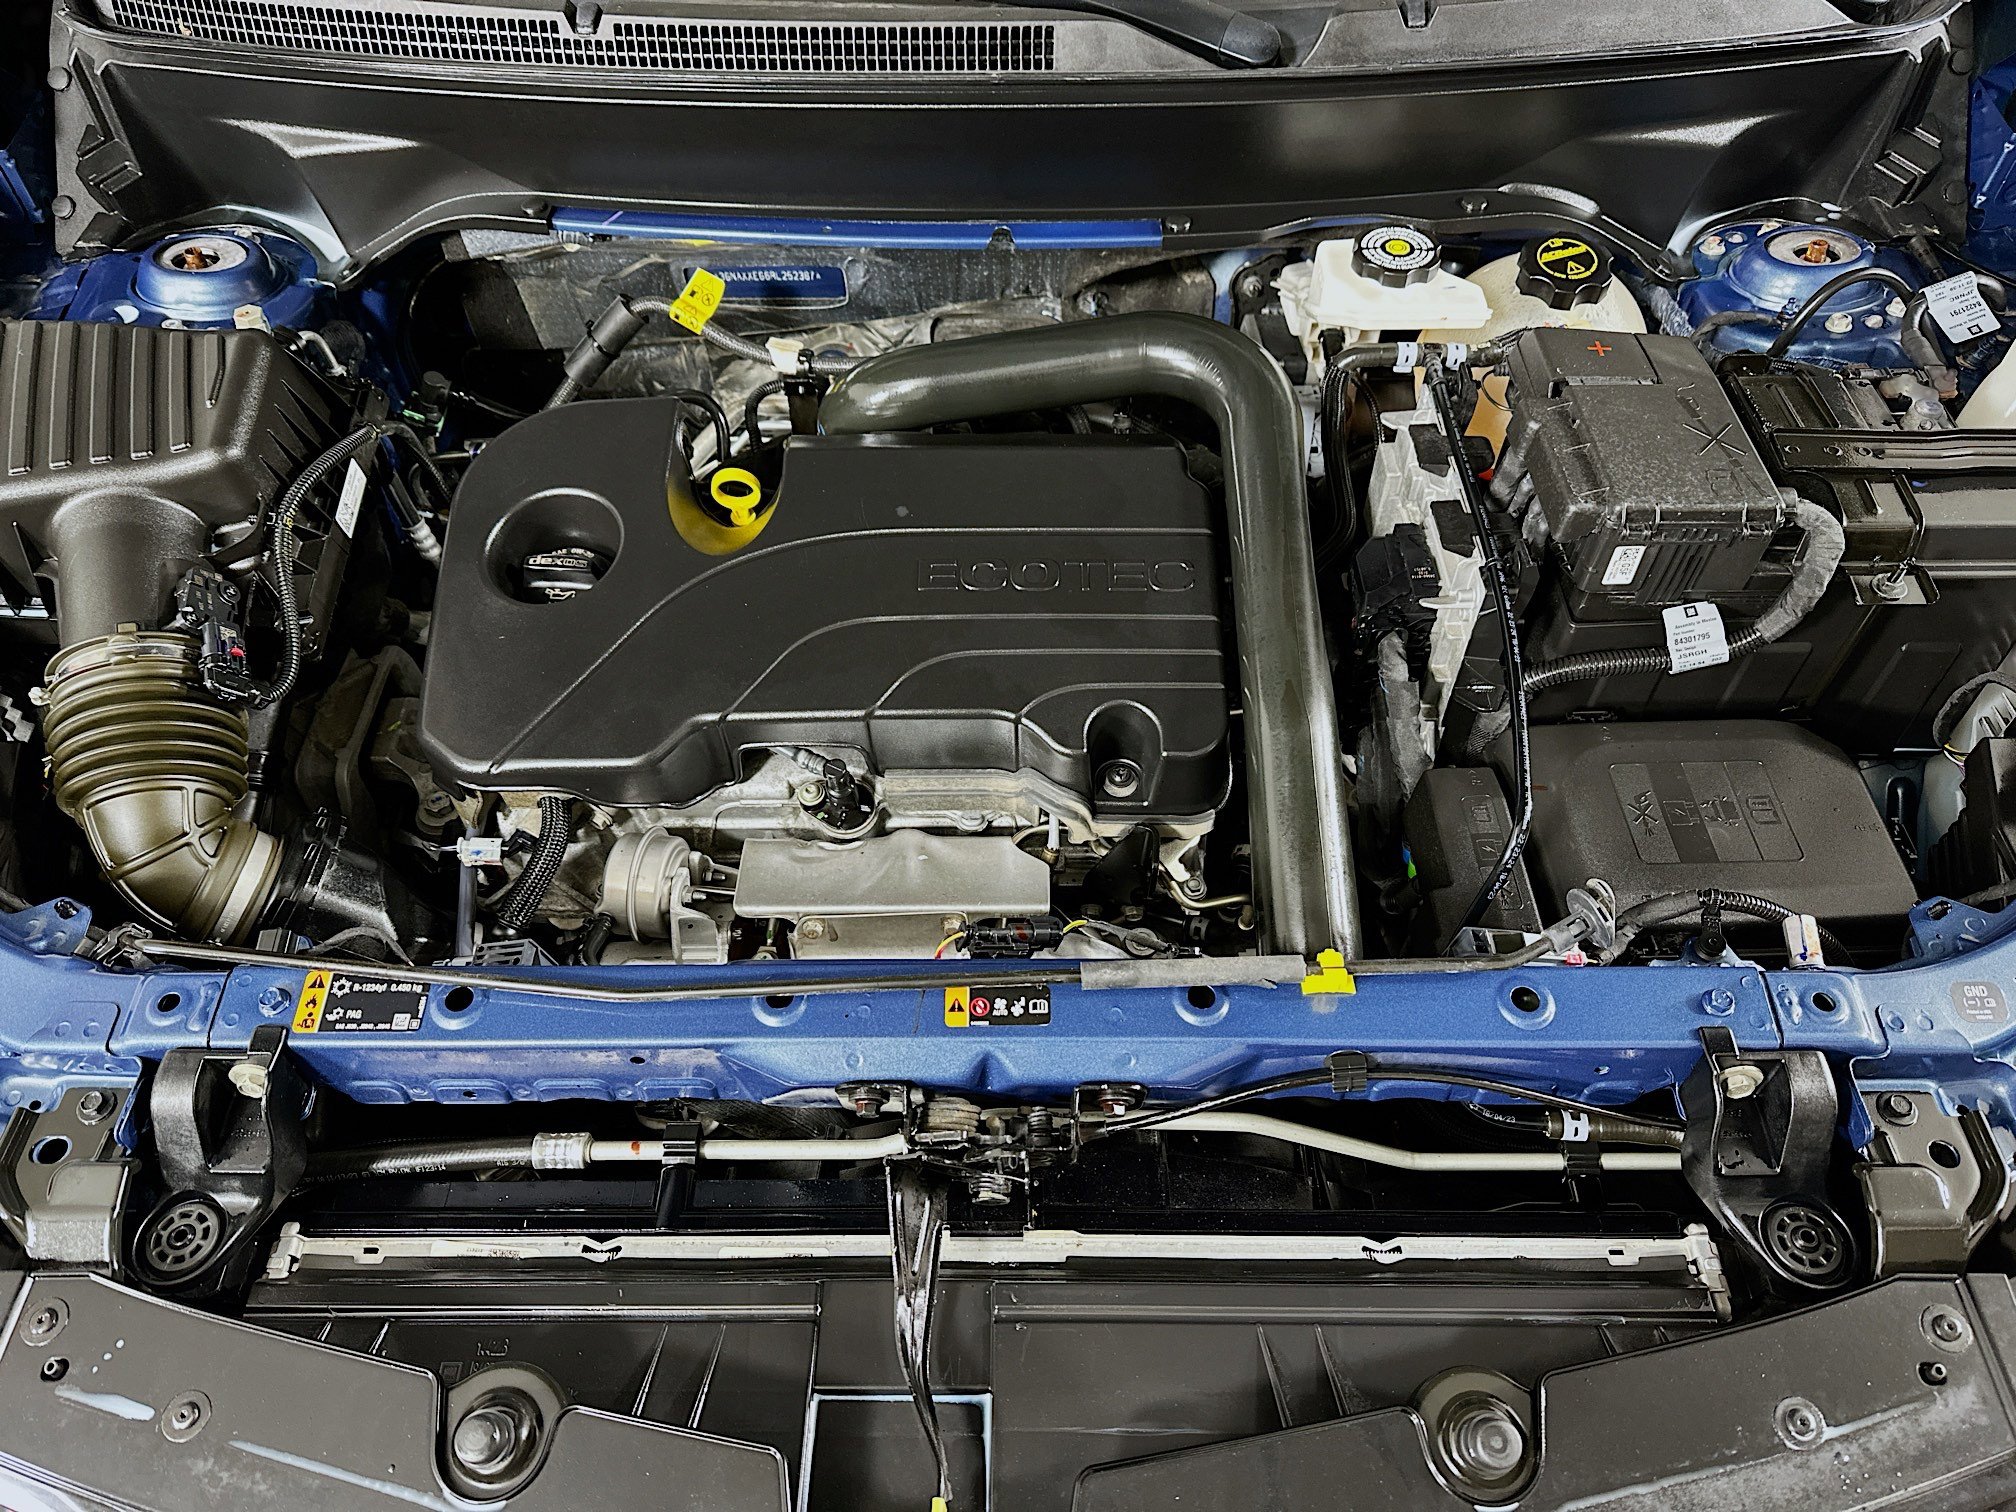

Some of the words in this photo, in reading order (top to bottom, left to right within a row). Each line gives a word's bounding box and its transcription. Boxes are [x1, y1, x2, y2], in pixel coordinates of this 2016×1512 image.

[1949, 301, 1982, 317] 84221791
[528, 555, 589, 568] dexos
[917, 558, 1197, 593] ECOTEC
[1674, 632, 1711, 646] 84301795
[1963, 985, 1988, 997] GND
[345, 1009, 362, 1019] PAG
[992, 1009, 1009, 1017] AUTO
